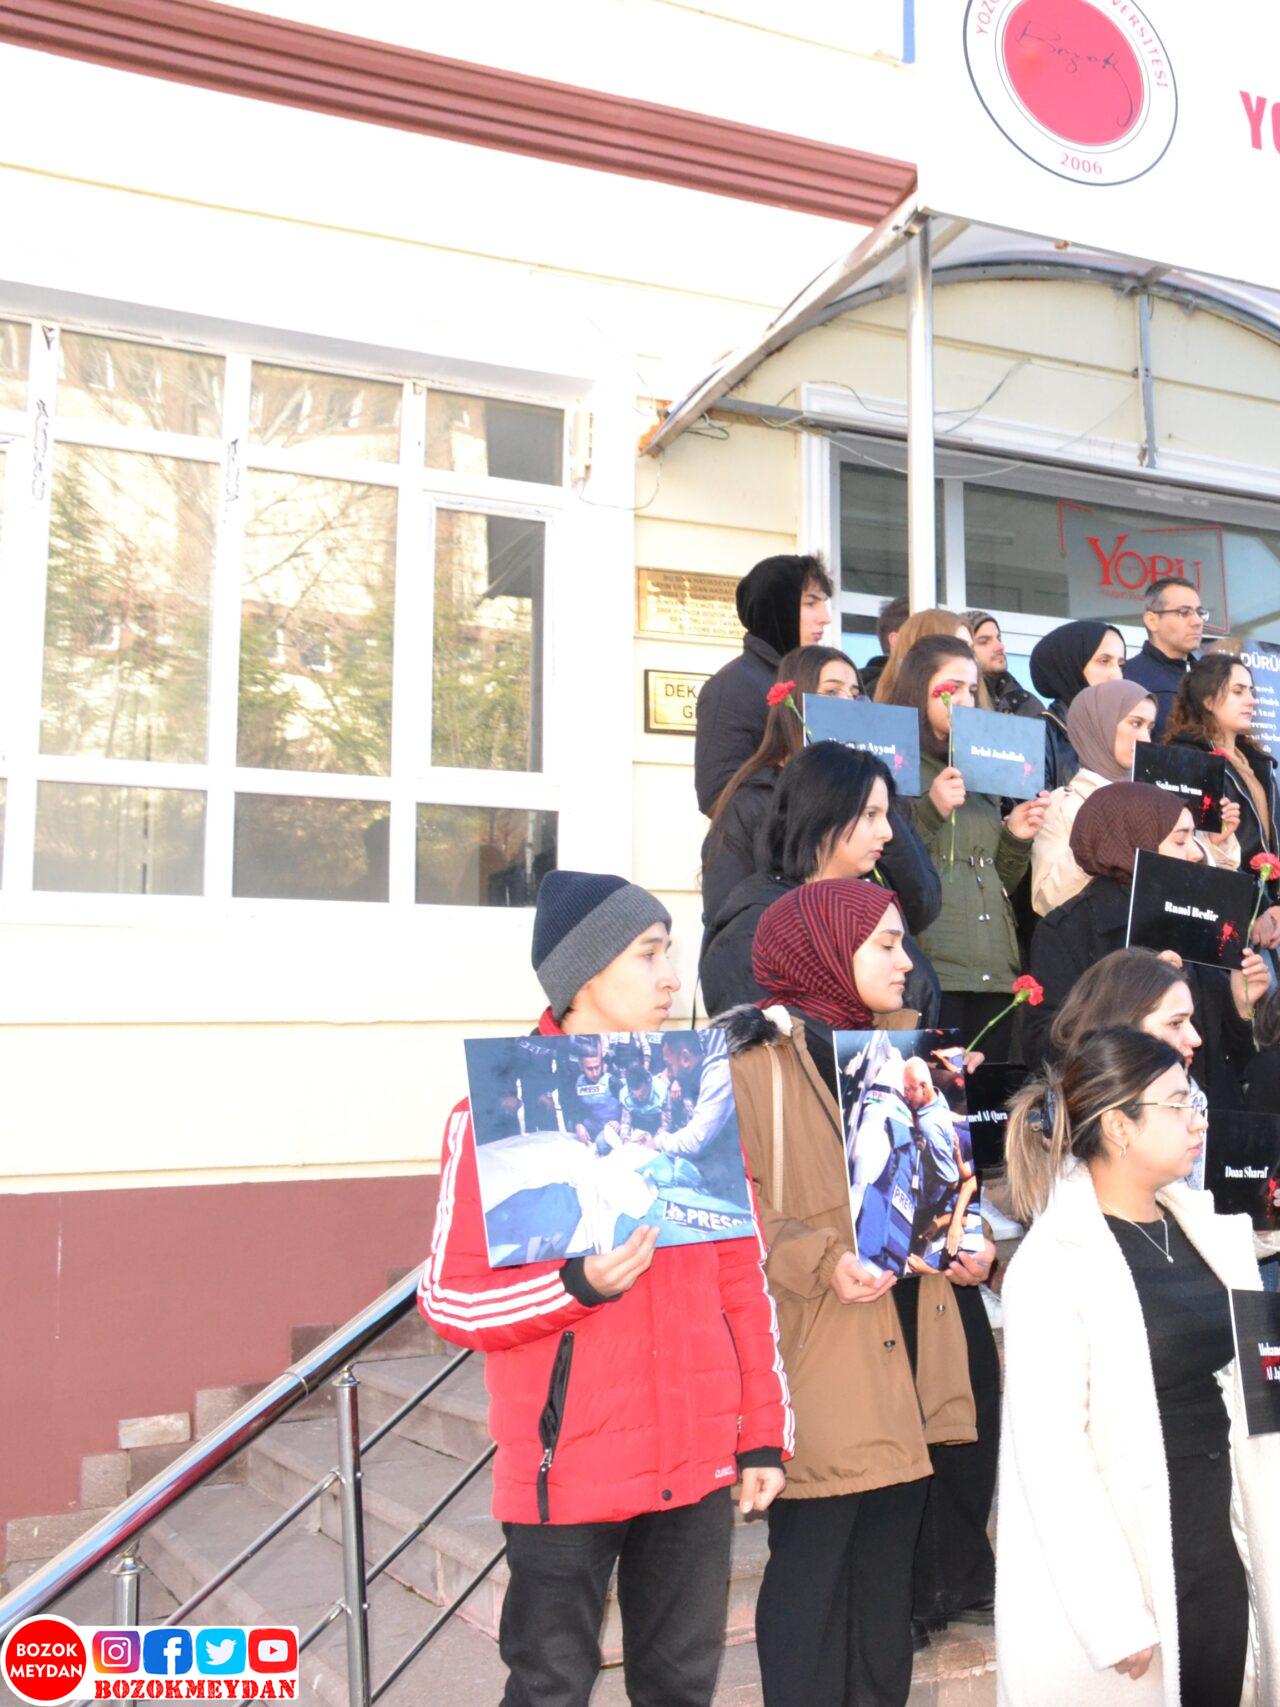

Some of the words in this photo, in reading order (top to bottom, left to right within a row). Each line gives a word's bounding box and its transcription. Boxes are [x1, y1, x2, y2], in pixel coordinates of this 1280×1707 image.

[1060, 152, 1103, 175] 2006
[665, 684, 697, 698] DEK
[1164, 900, 1191, 917] Rami
